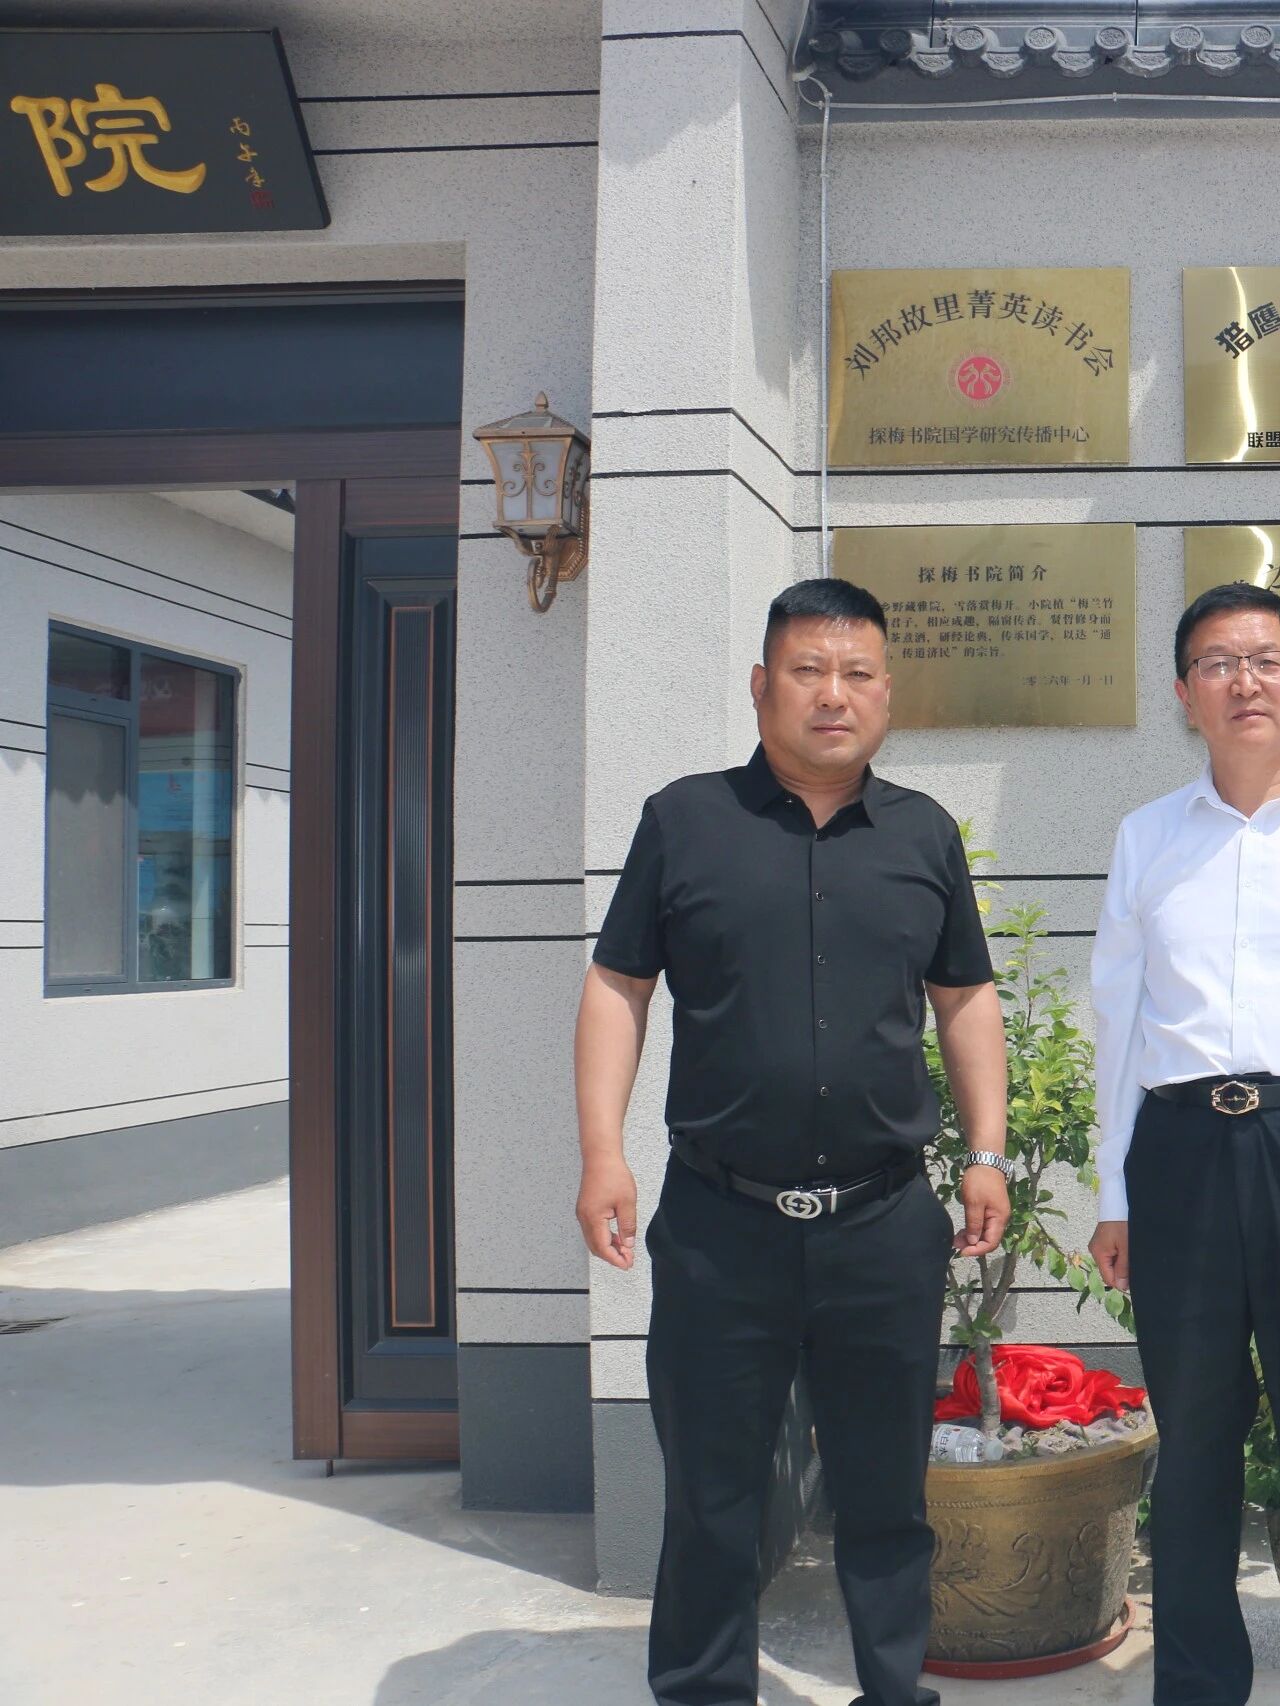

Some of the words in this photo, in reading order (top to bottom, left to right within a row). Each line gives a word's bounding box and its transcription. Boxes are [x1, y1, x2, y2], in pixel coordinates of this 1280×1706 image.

[11, 83, 206, 197] 院
[844, 289, 1114, 381] 刘邦故里菁英读书会
[868, 425, 1090, 445] 探梅书院国学研究传播中心
[918, 564, 1049, 584] 探梅书院简介
